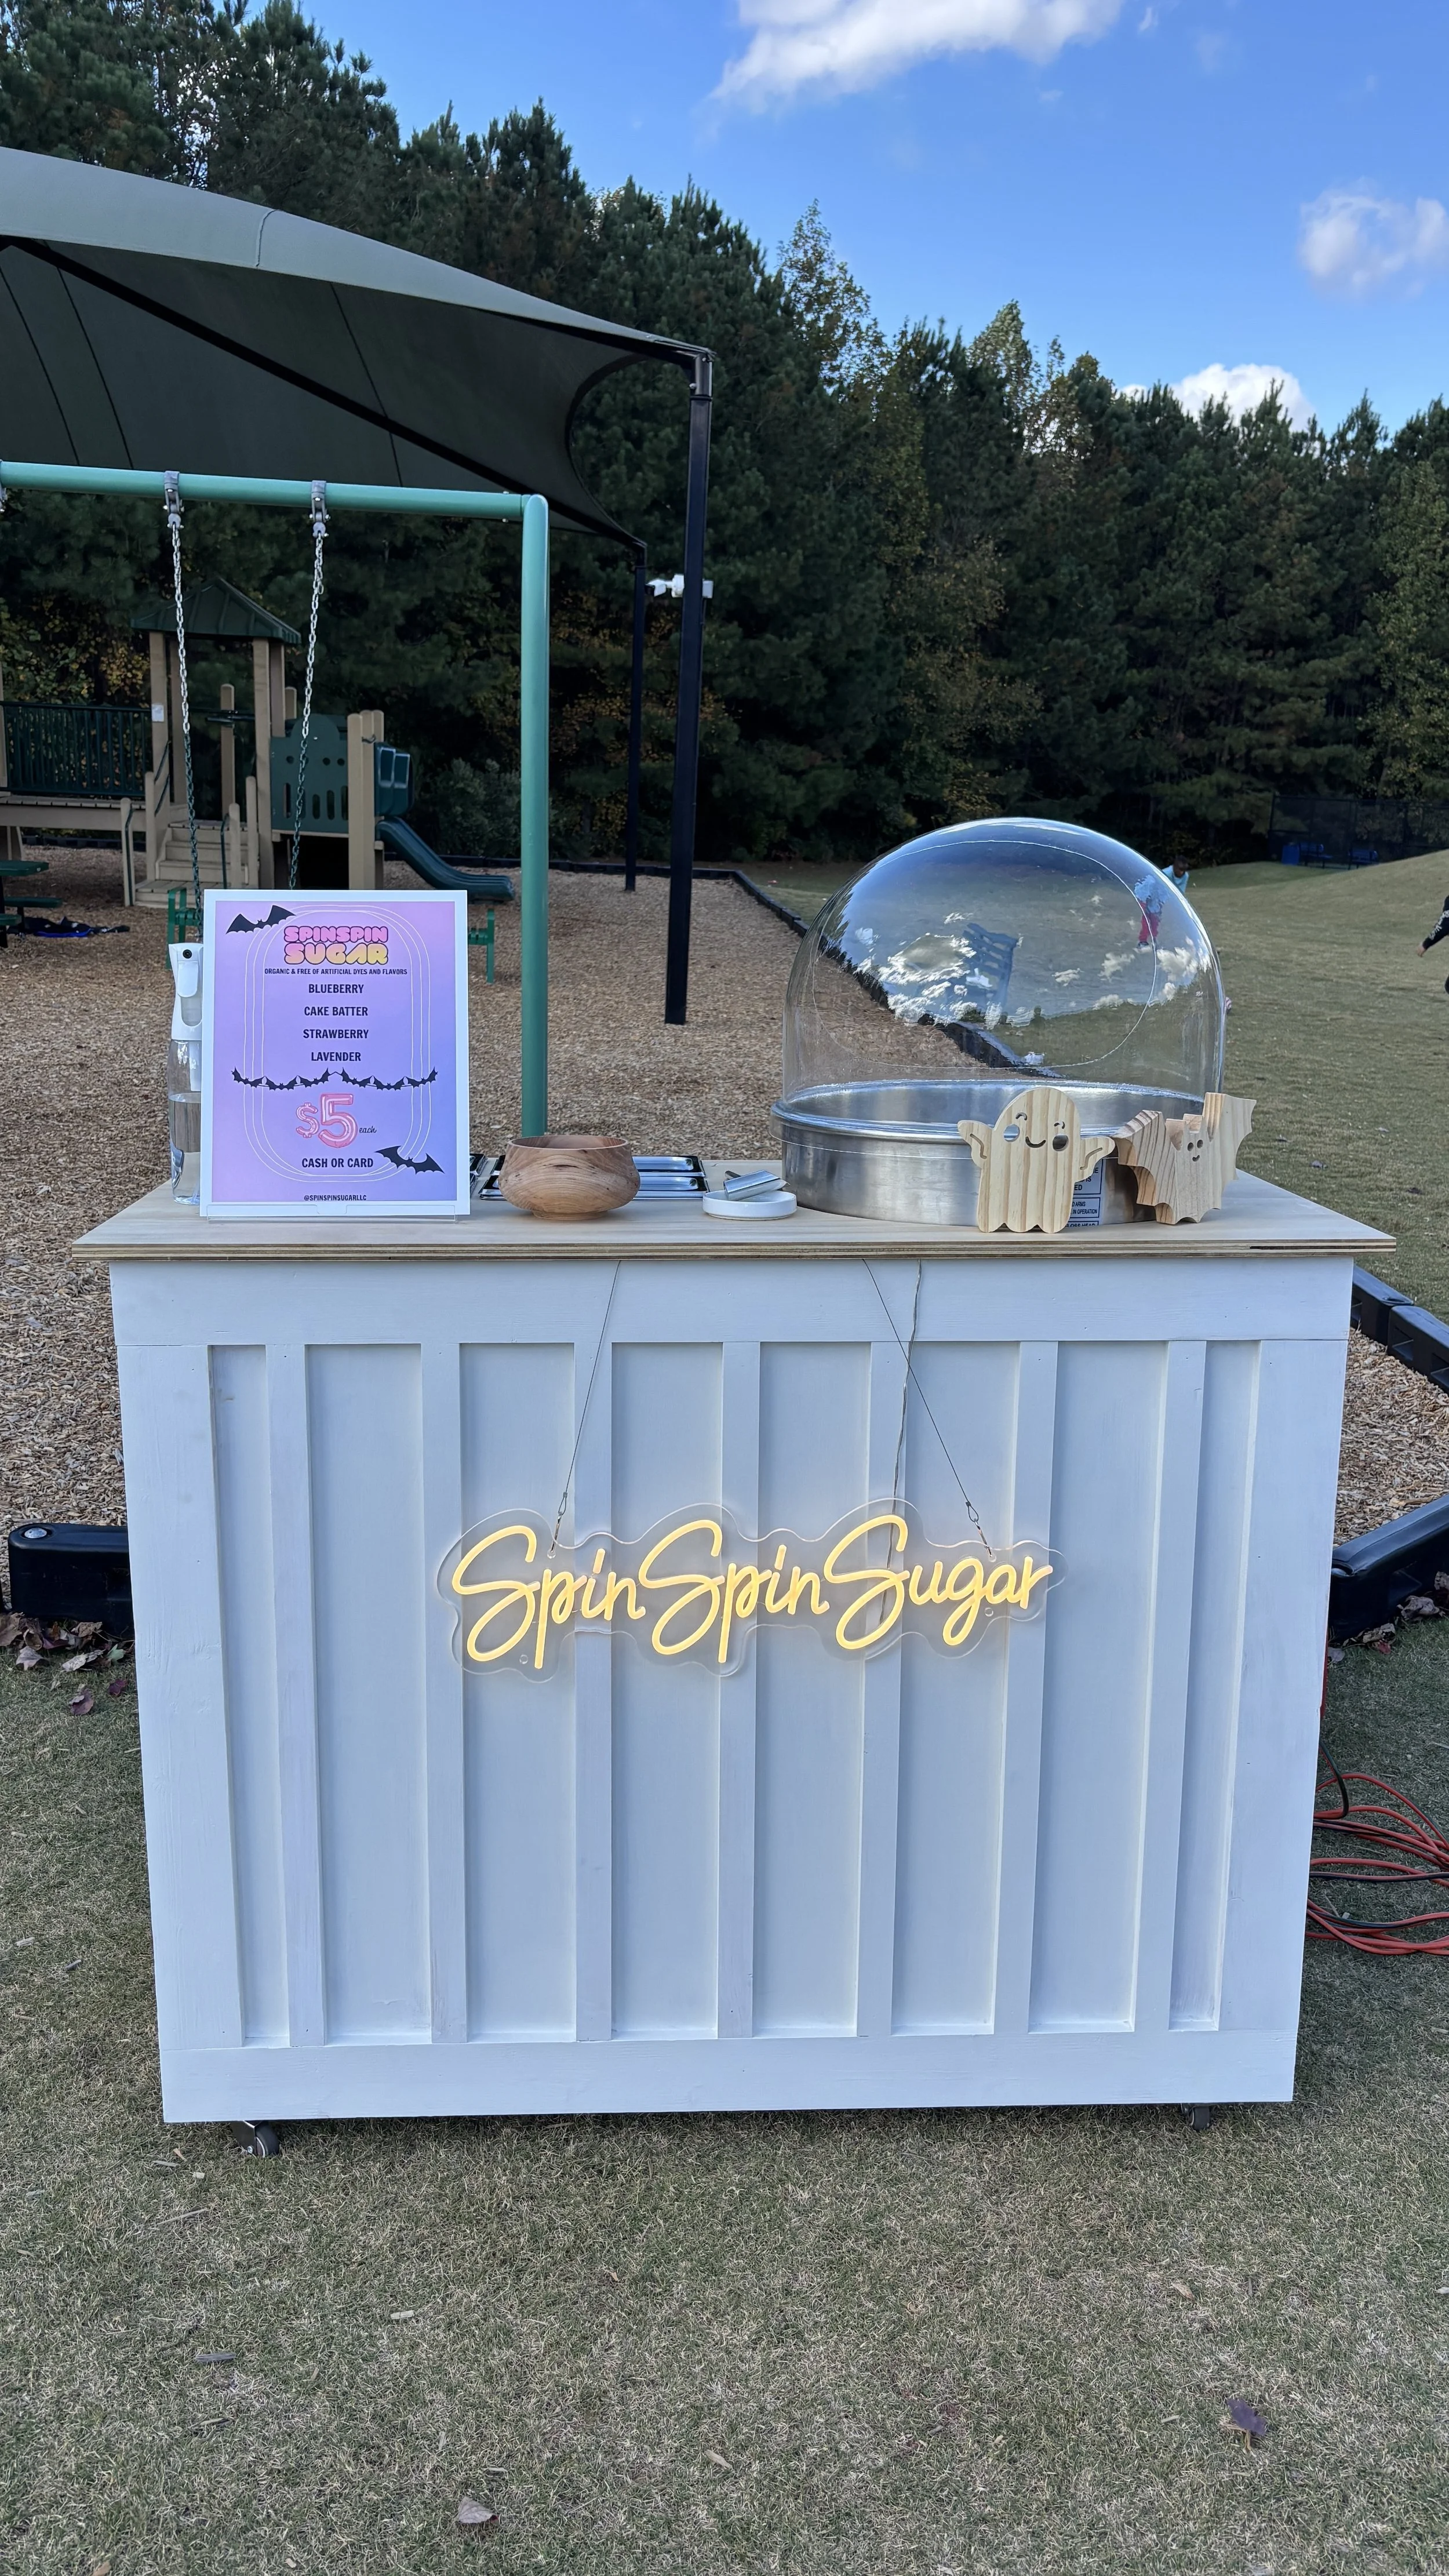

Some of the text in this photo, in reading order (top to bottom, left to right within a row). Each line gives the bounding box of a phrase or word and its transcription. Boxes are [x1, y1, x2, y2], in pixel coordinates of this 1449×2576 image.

[283, 926, 389, 943] SPINSPIN
[283, 942, 389, 965] SUGAR
[308, 984, 364, 994] BLUEBERRY
[304, 1006, 368, 1016] CAKE BATTER
[303, 1029, 369, 1039] STRAWBERRY
[311, 1051, 361, 1061] LAVENDER
[296, 1093, 358, 1148] $5
[301, 1158, 373, 1167] CASH OR CARD
[452, 1514, 1053, 1669] SpinSpinSugar
